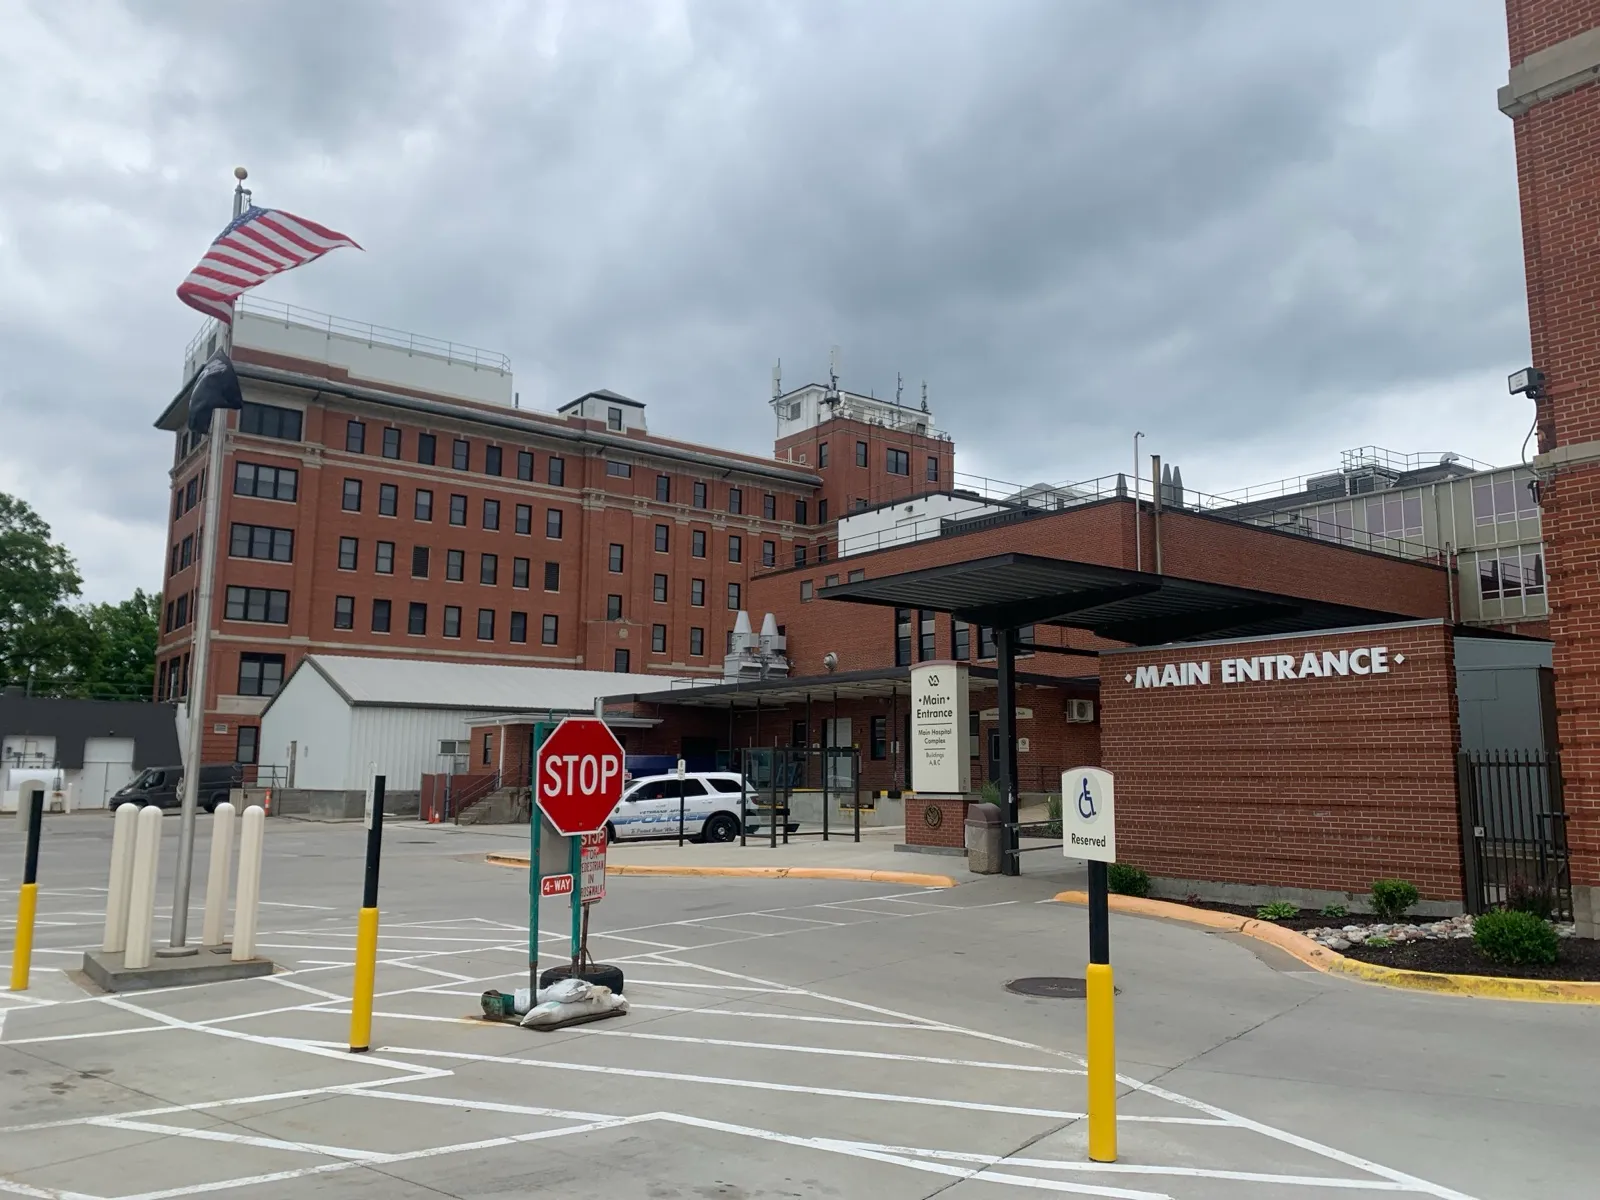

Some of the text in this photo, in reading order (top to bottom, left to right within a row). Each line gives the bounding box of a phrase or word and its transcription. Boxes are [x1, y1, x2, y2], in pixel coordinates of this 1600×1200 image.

[1135, 647, 1390, 689] MAIN ENTRANCE
[922, 694, 945, 705] Main
[916, 709, 953, 719] Entrance
[931, 728, 952, 736] Hospital
[924, 737, 946, 745] Complex
[544, 755, 618, 797] STOP
[626, 812, 699, 825] POLICE
[581, 830, 605, 846] STOP
[1071, 833, 1106, 848] Reserved
[581, 861, 604, 873] EDESTRIAN
[587, 874, 595, 884] IN
[543, 878, 571, 893] 4-WAY
